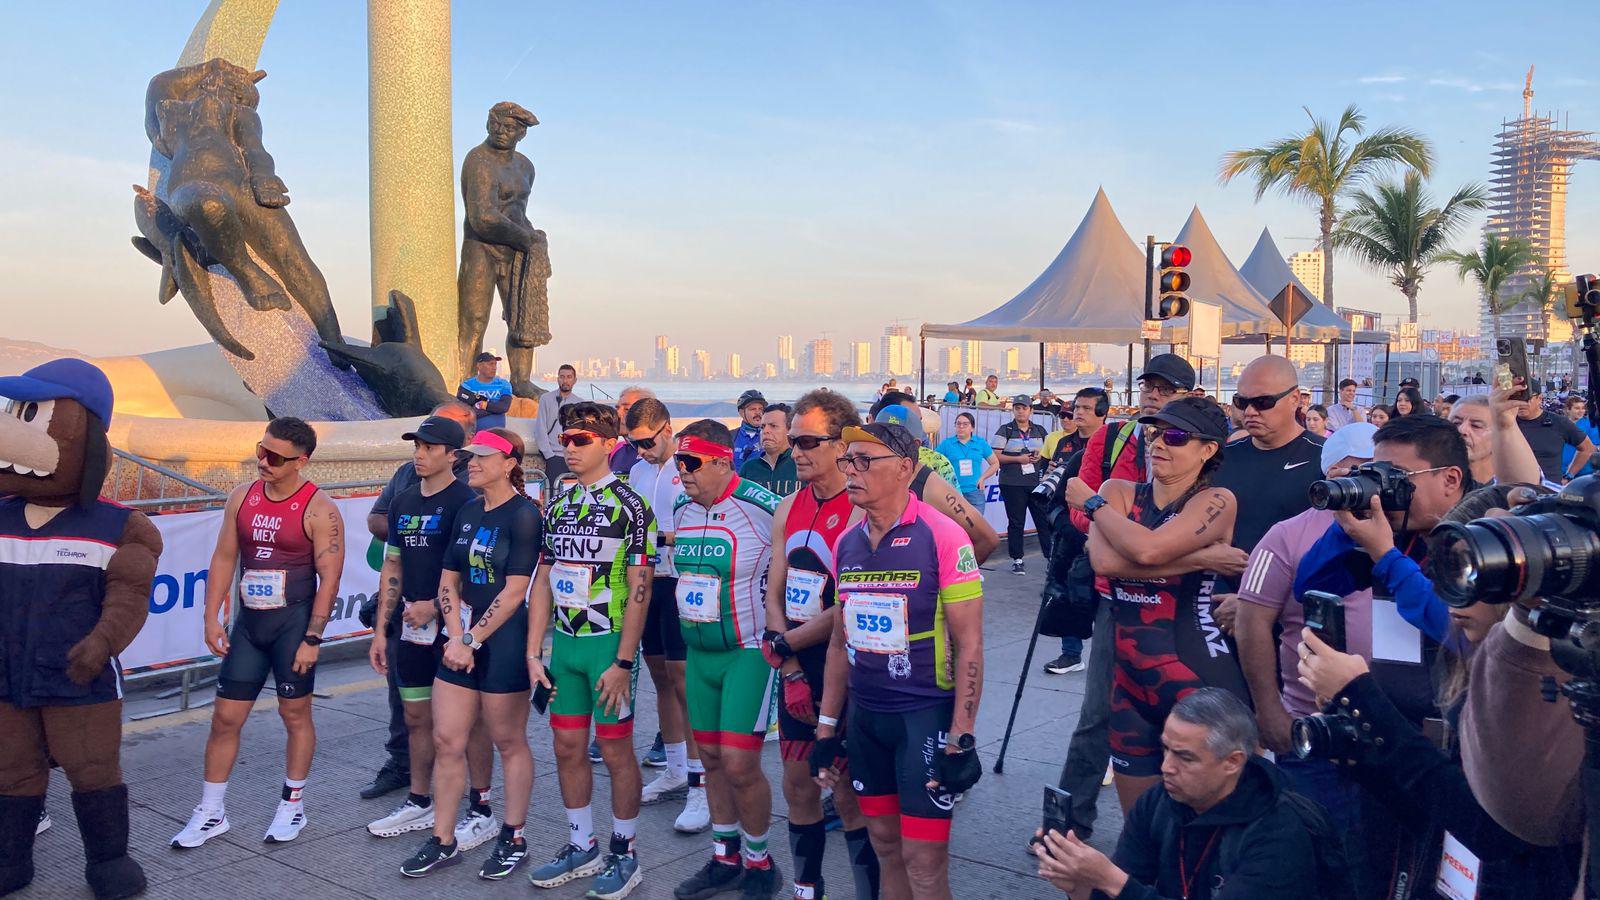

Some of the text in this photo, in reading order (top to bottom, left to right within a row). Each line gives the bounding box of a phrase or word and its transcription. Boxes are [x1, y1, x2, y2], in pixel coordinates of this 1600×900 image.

[1560, 492, 1584, 502] Canon
[252, 514, 282, 530] ISAAC
[627, 494, 645, 527] MEXICO
[636, 528, 646, 547] CITY
[253, 528, 276, 543] MEX
[557, 525, 600, 536] CONADE
[405, 536, 429, 547] FELIX
[553, 537, 603, 560] GFNY
[57, 550, 88, 558] TECHRON
[839, 571, 919, 583] PESTAÑAS
[248, 584, 273, 596] 538
[556, 579, 575, 594] 48
[685, 591, 704, 606] 46
[787, 586, 810, 605] 527
[856, 613, 893, 633] 539
[1444, 852, 1474, 881] PRENSA
